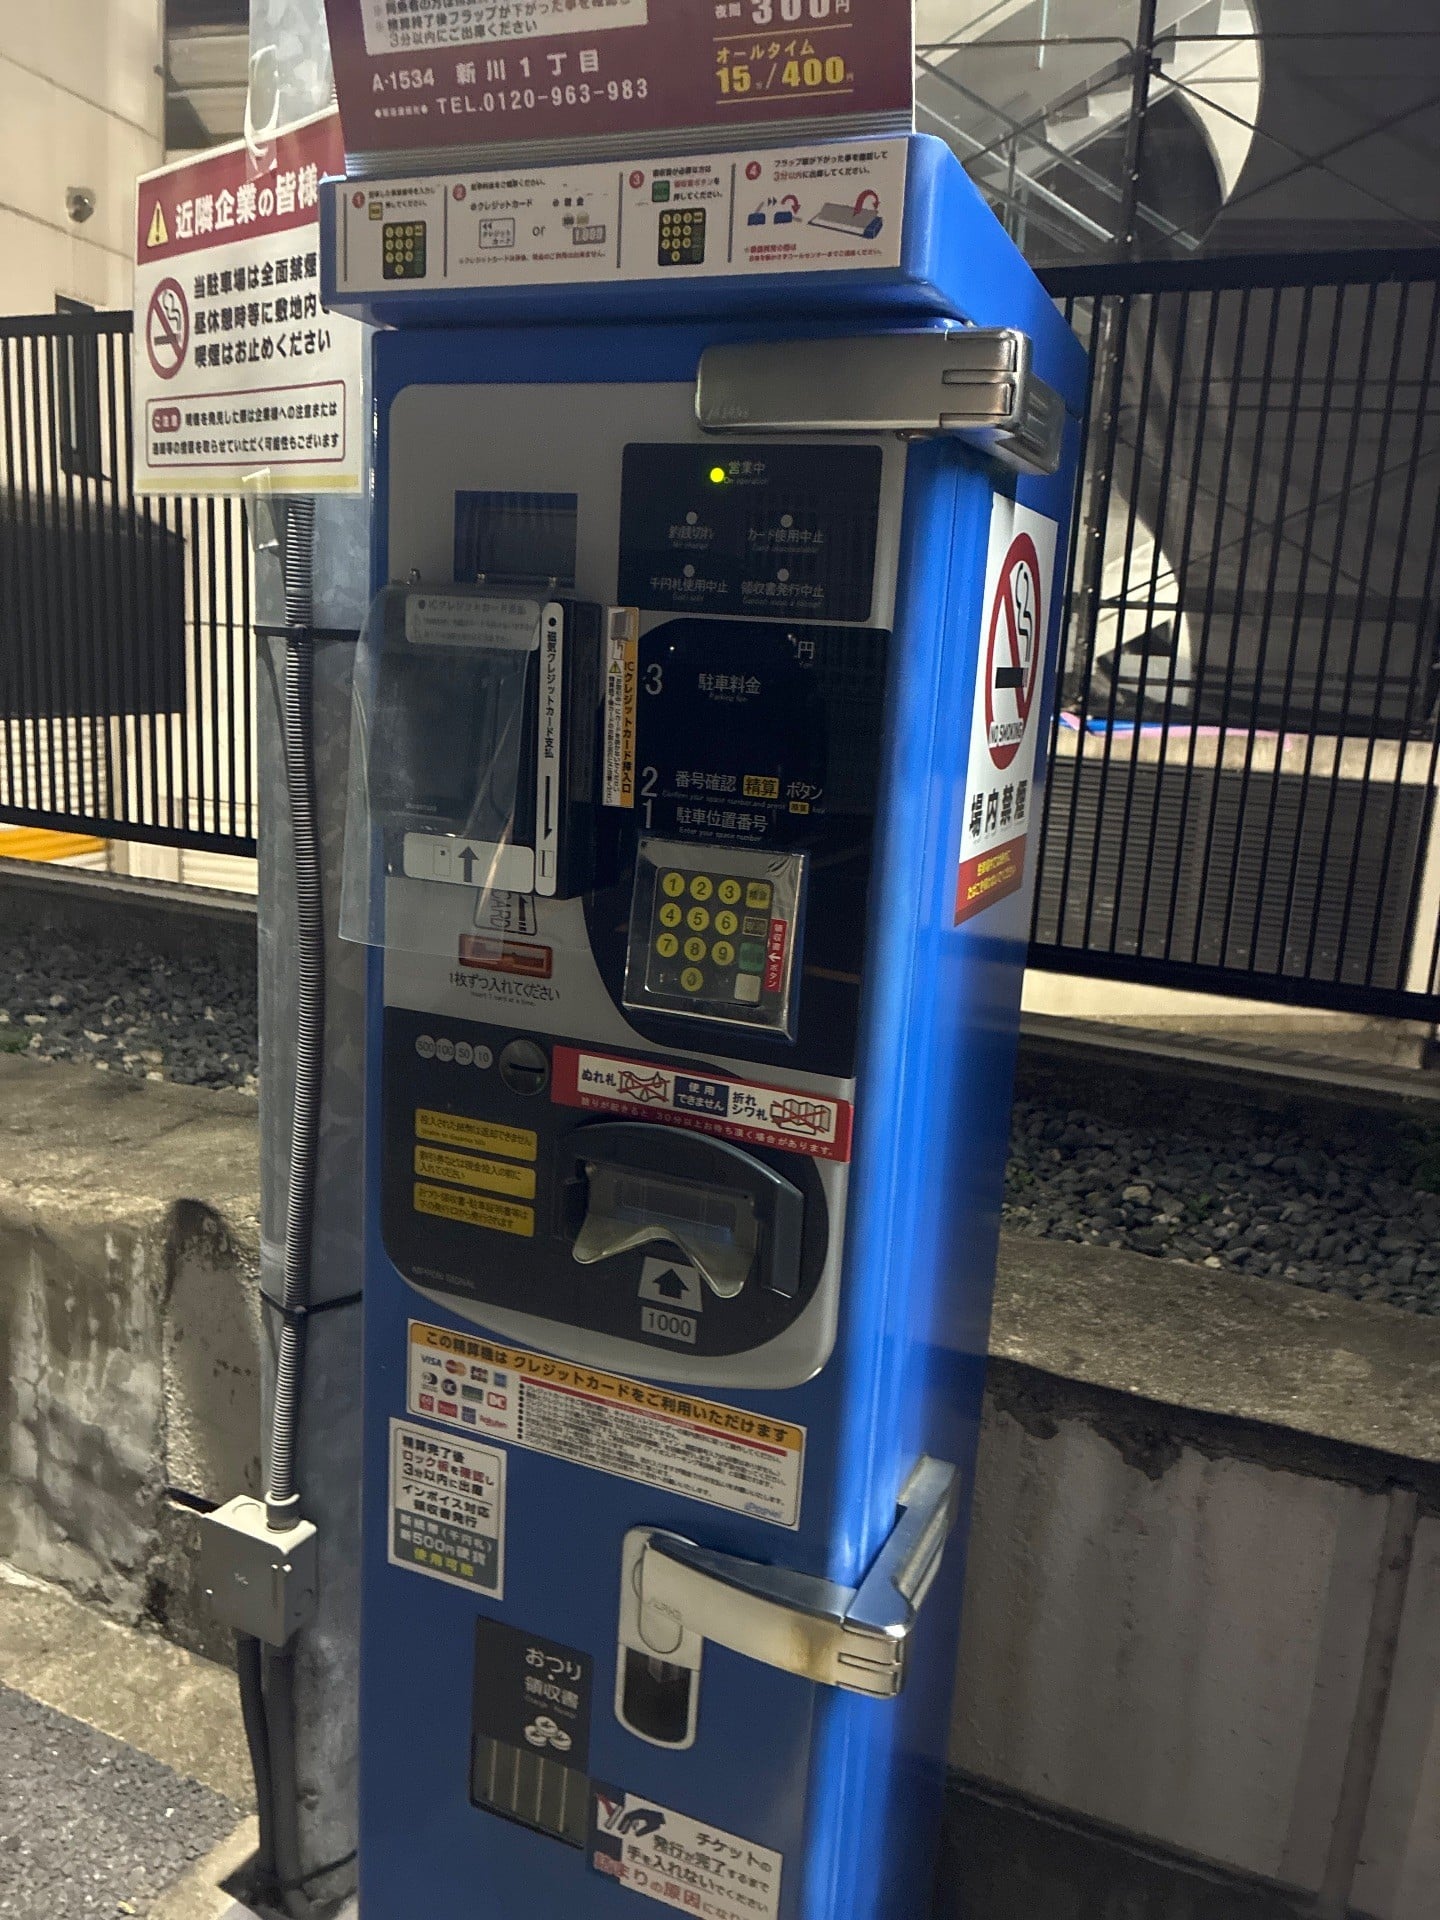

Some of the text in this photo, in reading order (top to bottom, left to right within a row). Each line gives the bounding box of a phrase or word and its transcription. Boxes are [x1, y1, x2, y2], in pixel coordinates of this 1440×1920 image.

[716, 38, 815, 64] オールタイム
[436, 78, 649, 116] TEL.0120-963-983
[175, 166, 319, 240] 近隣企業の皆様
[532, 226, 546, 237] or
[194, 252, 317, 299] 当駐車場は全面禁煙
[194, 327, 331, 368] 喫煙はお止めください
[650, 577, 729, 593] 千円札使用中止
[797, 641, 815, 660] 円
[645, 664, 761, 695] 3 駐車料金
[641, 766, 823, 800] 2 番号確認 精算 ボタン
[642, 798, 769, 832] 1 駐車位置番号
[969, 780, 1028, 838] 場内禁煙
[669, 878, 677, 892] 1
[696, 881, 707, 896] 2
[724, 885, 734, 900] 3
[665, 908, 675, 923] 4
[692, 912, 703, 927] 5
[721, 915, 731, 930] 6
[663, 938, 673, 952] 7
[690, 942, 700, 956] 8
[718, 946, 728, 961] 9
[449, 972, 560, 1001] 1枚ずつ入れてください
[686, 972, 697, 987] 0
[581, 1068, 617, 1087] ぬれ札
[688, 1081, 716, 1096] 使用
[677, 1092, 725, 1112] できません
[731, 1103, 768, 1121] シワ札
[732, 1091, 757, 1107] 折れ
[648, 1313, 691, 1337] 1000
[421, 1354, 442, 1368] VISA
[425, 1332, 508, 1365] この精算機は
[513, 1354, 789, 1443] クレジットカードをご利用いただけます
[403, 1435, 466, 1464] 精算完了後
[403, 1484, 490, 1519] インボイス対応
[414, 1500, 478, 1529] 領収書発行
[524, 1647, 582, 1681] おつり
[652, 1834, 770, 1893] 発行が完了するまで
[696, 1832, 772, 1872] チケットの
[593, 1851, 750, 1920] 詰まりの原因になり
[626, 1845, 769, 1913] 手を入れないでください
